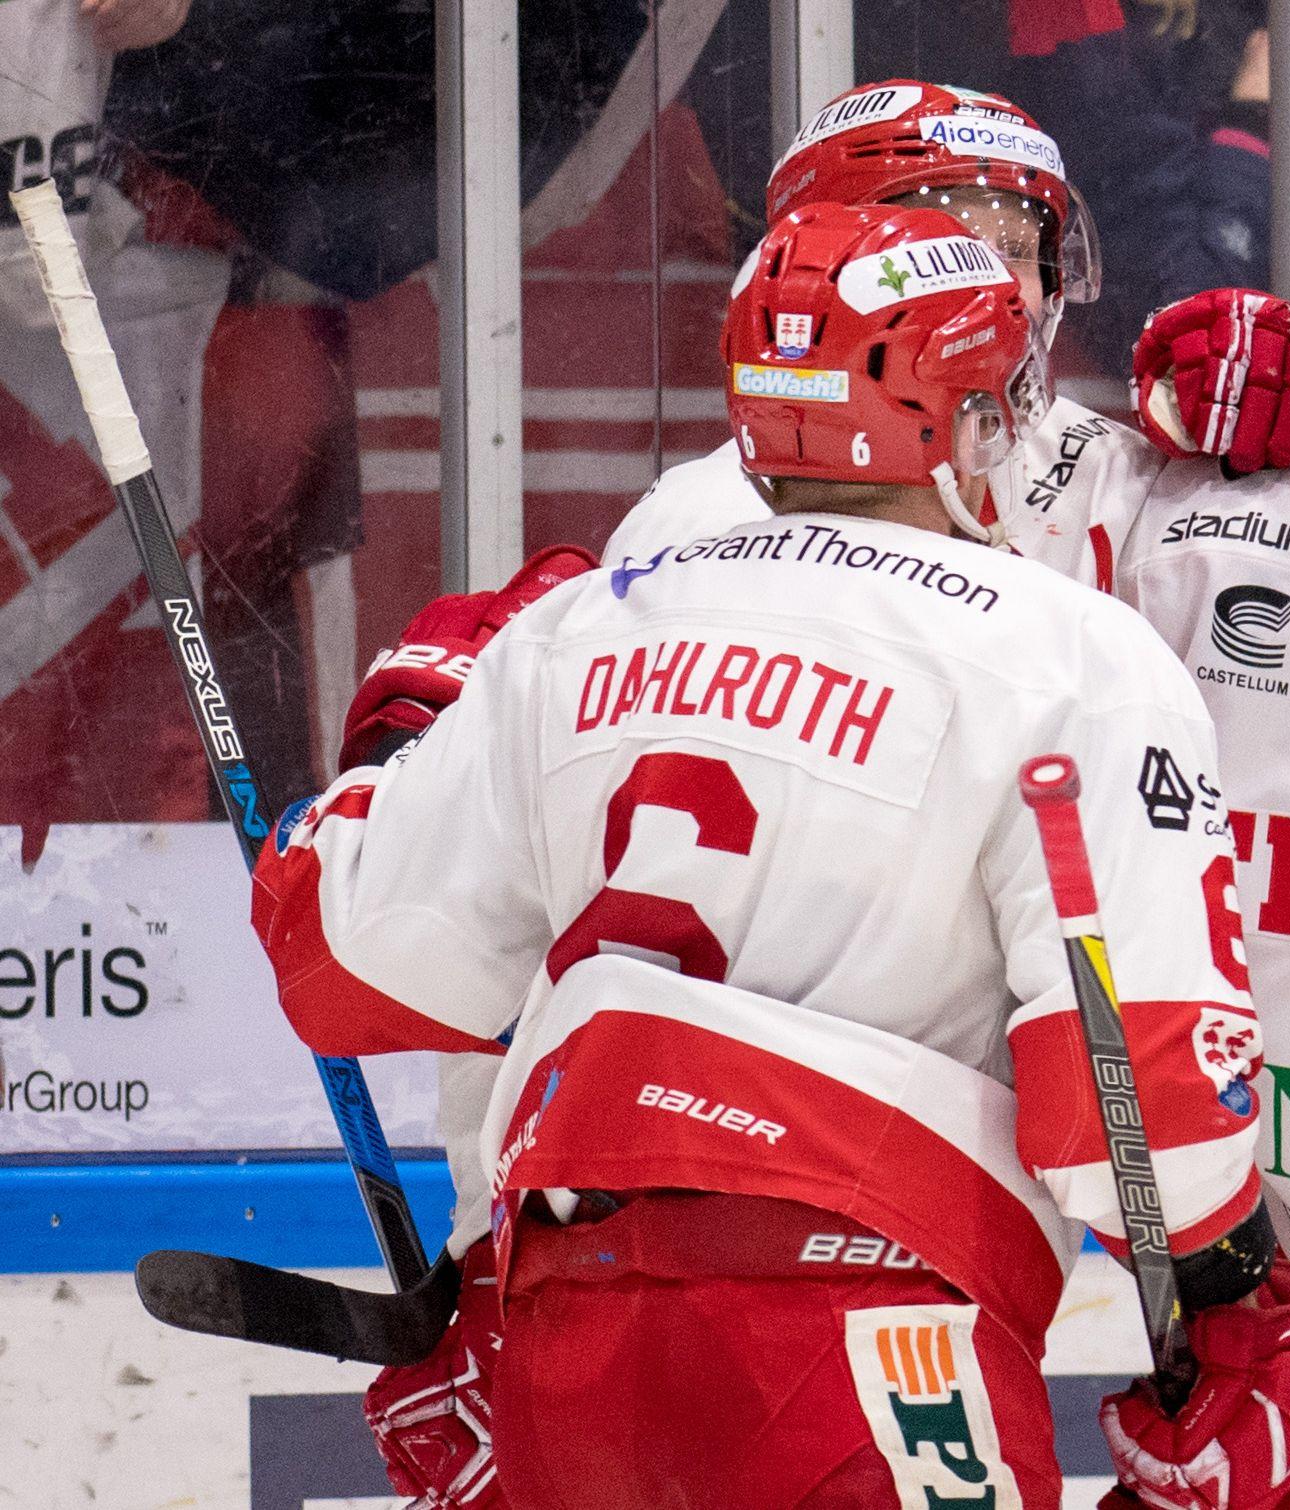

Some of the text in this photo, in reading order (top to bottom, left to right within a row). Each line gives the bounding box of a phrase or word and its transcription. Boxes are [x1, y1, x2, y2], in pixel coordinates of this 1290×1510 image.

[906, 242, 994, 278] LILIUM
[851, 431, 871, 467] 6
[675, 524, 1000, 615] Grant Thornton
[164, 598, 245, 762] NEXUS
[575, 640, 895, 766] DAHLROTH
[1196, 665, 1290, 696] CASTELLUM
[546, 751, 759, 987] 6
[3, 1070, 150, 1122] rGroup
[636, 1083, 788, 1145] BAUER
[1091, 1053, 1170, 1257] BAUER
[799, 1233, 937, 1271] BAU
